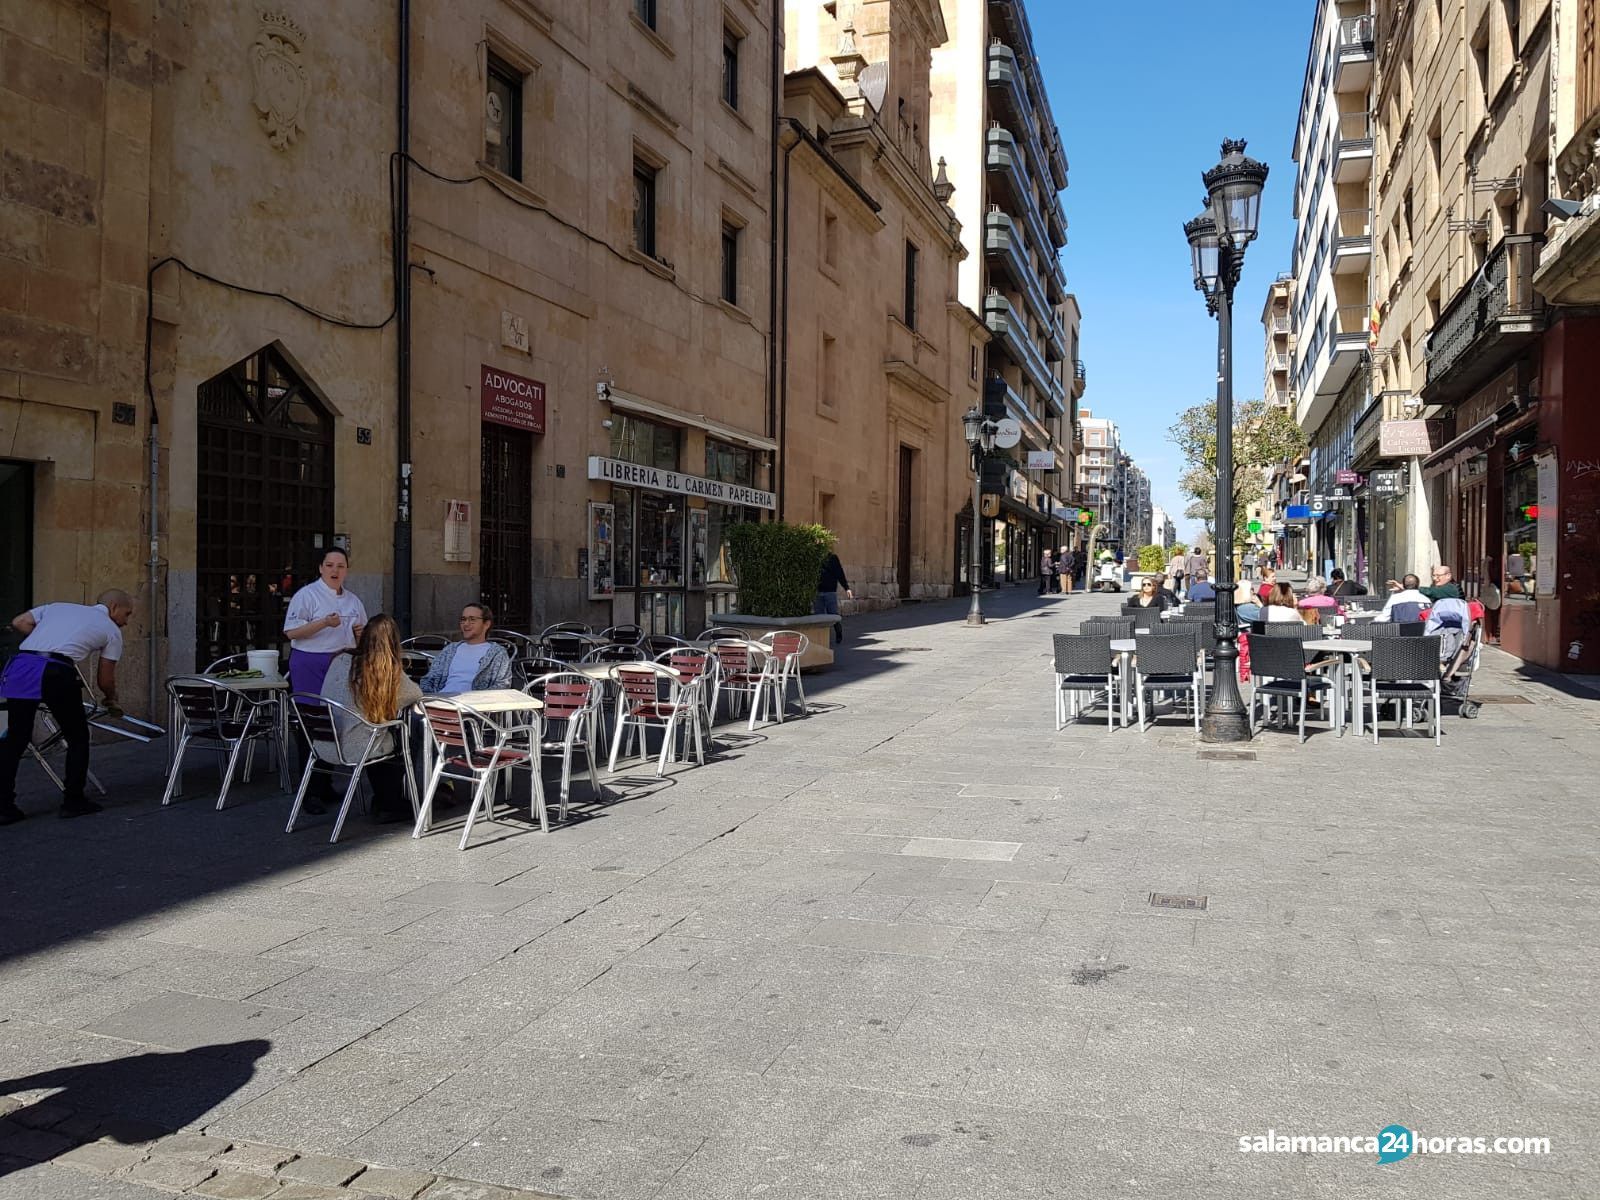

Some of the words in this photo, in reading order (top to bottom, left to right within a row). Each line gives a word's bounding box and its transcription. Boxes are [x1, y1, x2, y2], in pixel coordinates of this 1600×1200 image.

[485, 373, 541, 400] ADVOCATI
[495, 394, 532, 410] ABOGADOS
[603, 461, 660, 487] LIBRERIA
[666, 474, 680, 490] EL
[685, 478, 724, 498] CARMEN
[729, 486, 772, 506] PAPELERIA
